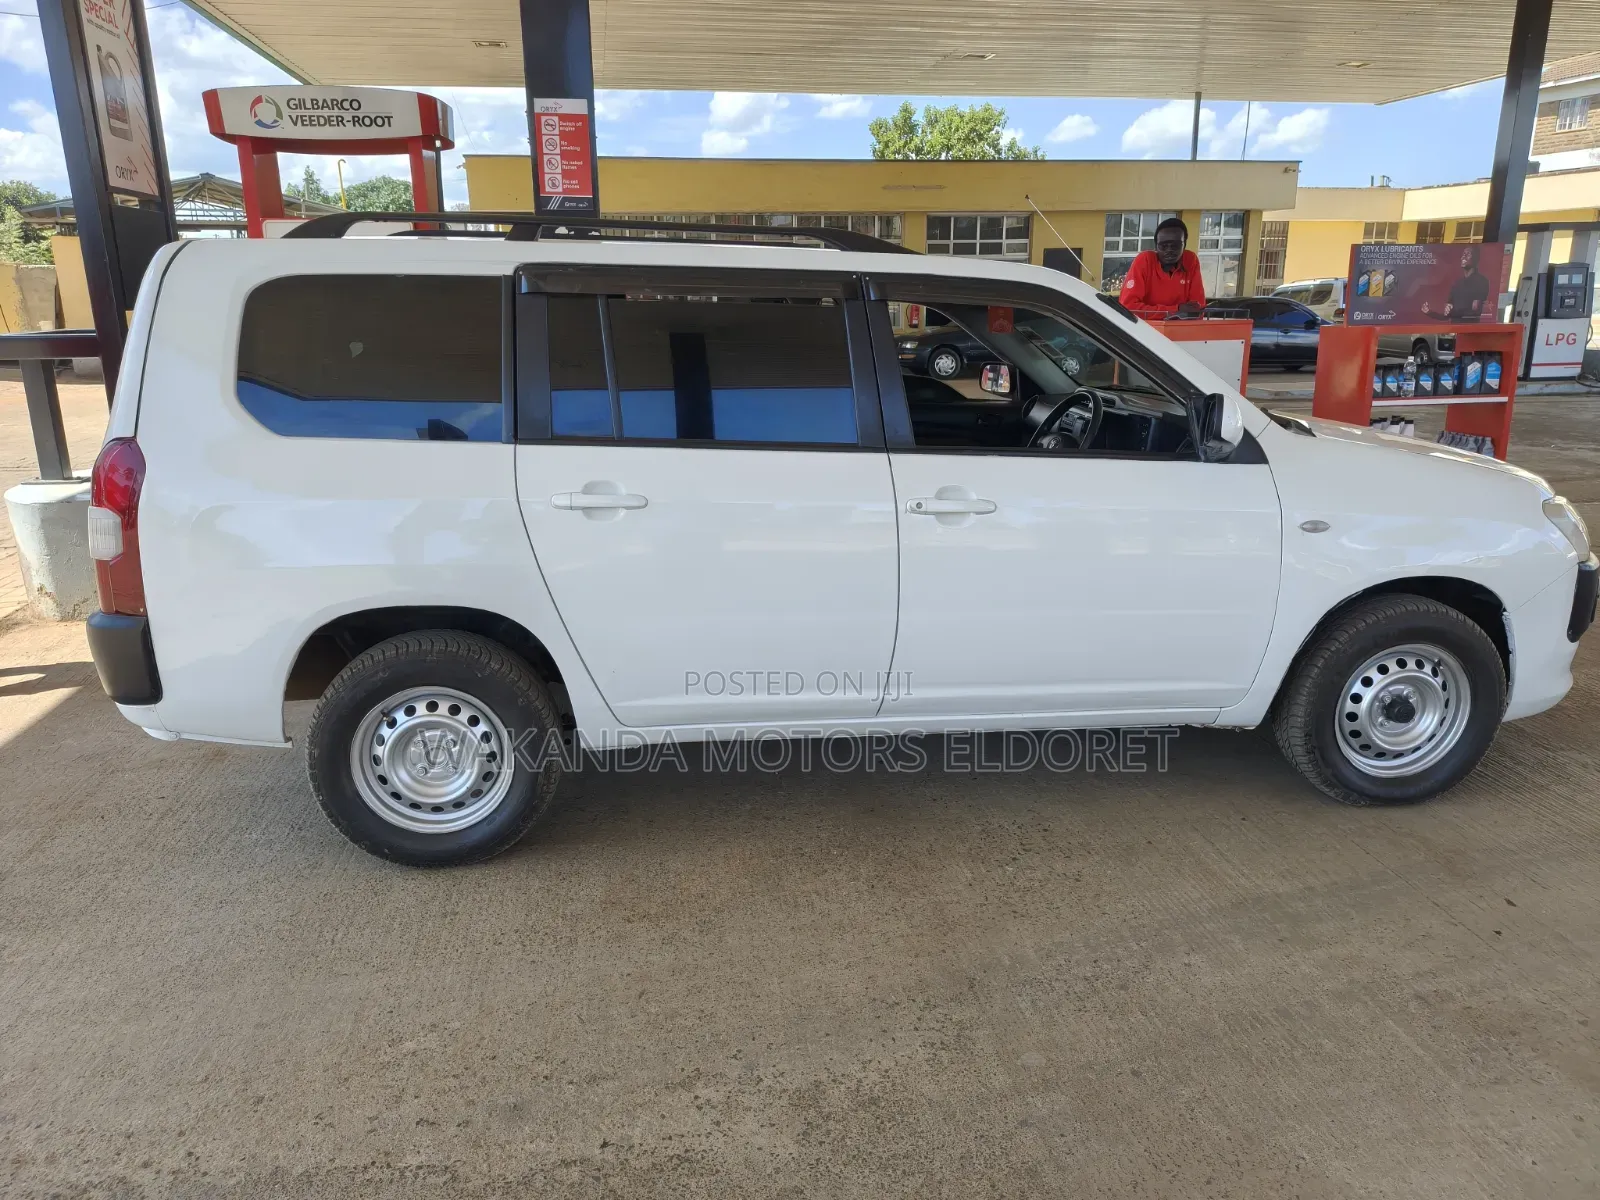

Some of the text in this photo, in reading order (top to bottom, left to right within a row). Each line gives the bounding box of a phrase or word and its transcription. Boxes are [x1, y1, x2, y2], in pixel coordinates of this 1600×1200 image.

[83, 0, 119, 30] SPECIAL
[286, 97, 362, 111] GILBARCO
[288, 114, 393, 128] VEEDER-ROOT
[115, 165, 134, 181] ORYX
[1545, 332, 1577, 346] LPG
